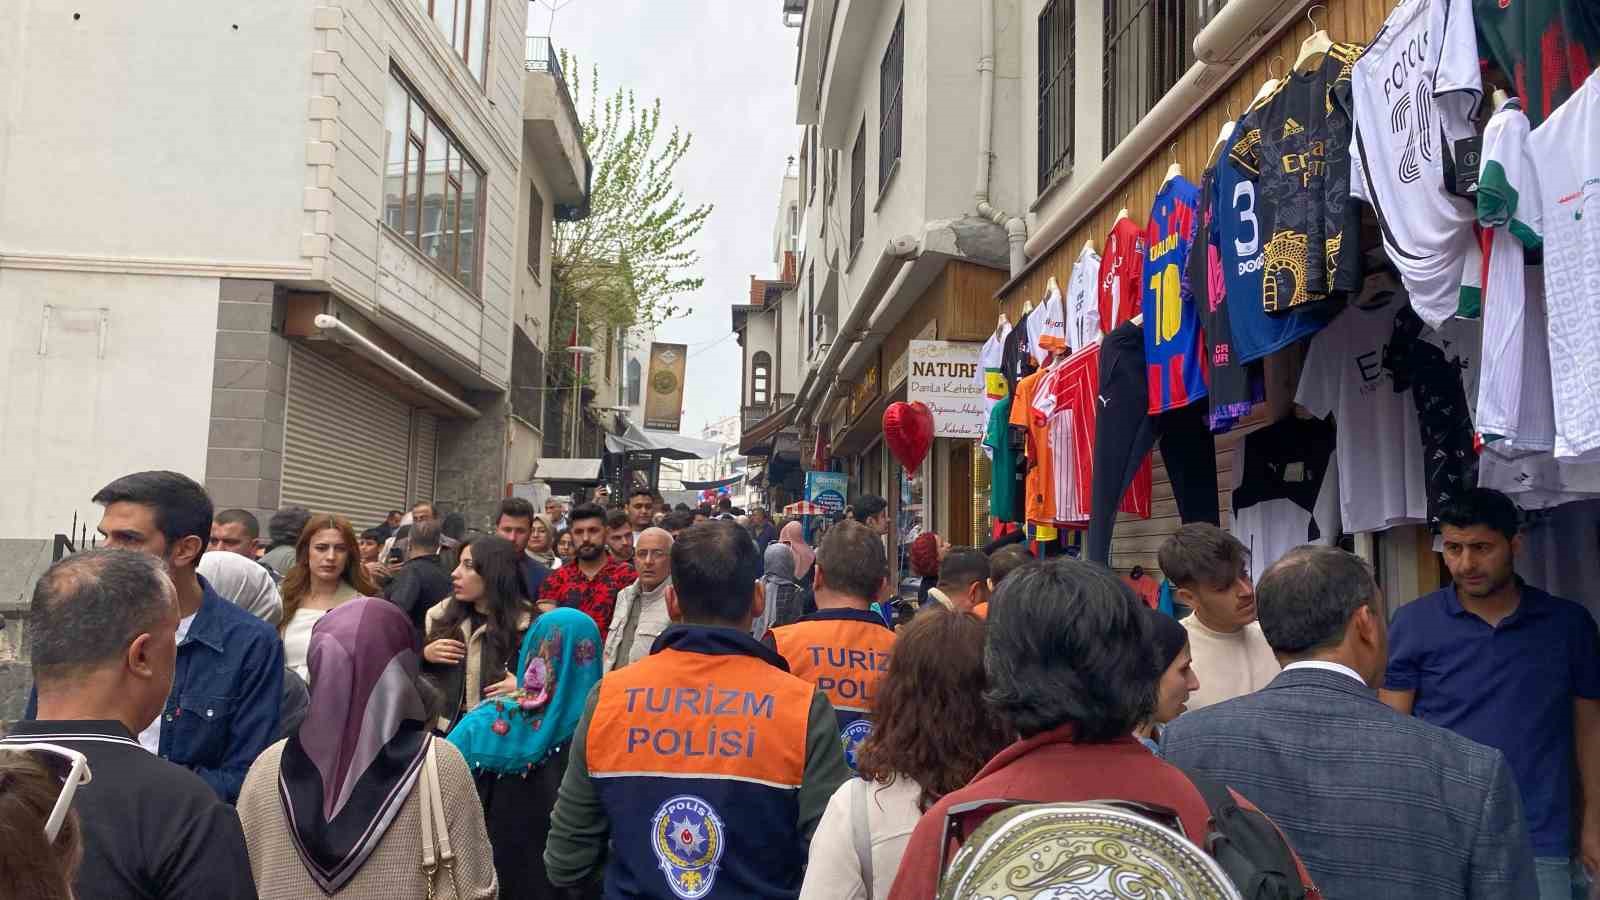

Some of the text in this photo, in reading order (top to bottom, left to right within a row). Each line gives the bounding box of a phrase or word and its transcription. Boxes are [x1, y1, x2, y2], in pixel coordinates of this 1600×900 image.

[1233, 180, 1259, 256] 3
[1150, 264, 1182, 346] 10
[624, 681, 775, 720] TURİZM
[627, 724, 757, 758] POLİSİ
[668, 801, 707, 817] POLİS
